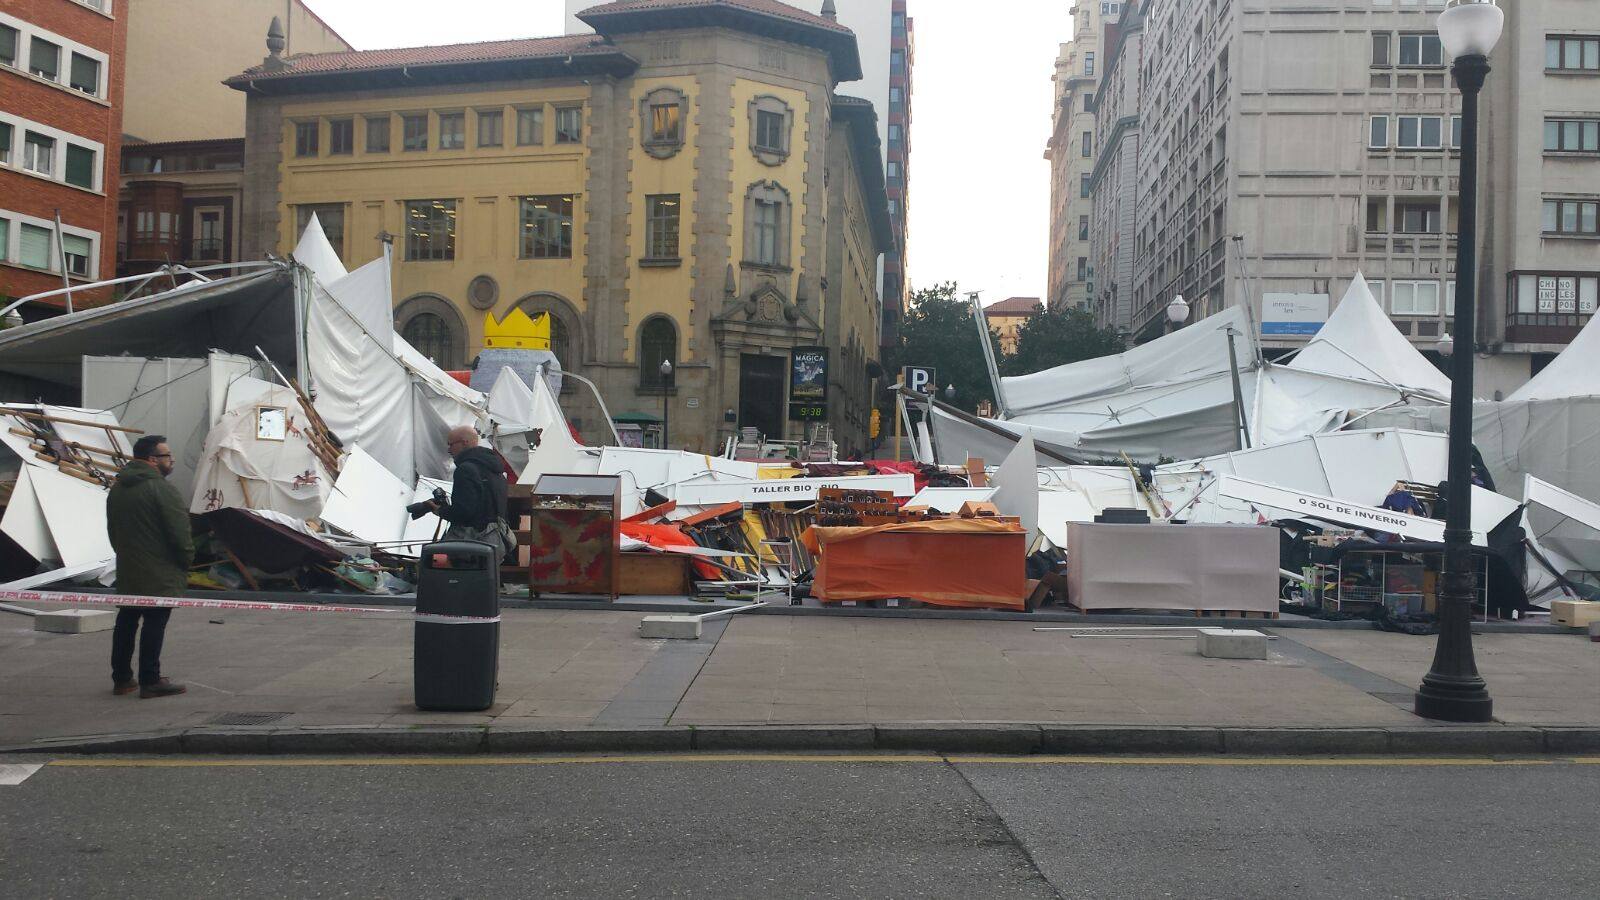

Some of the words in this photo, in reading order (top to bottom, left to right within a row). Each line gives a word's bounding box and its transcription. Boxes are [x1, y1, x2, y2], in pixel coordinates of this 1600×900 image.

[912, 368, 929, 392] P
[801, 407, 822, 416] 9:38
[752, 485, 791, 494] TALLER
[793, 484, 812, 493] BIO
[1310, 500, 1333, 511] SOL
[1336, 506, 1351, 515] DE
[1354, 510, 1408, 527] INVERNO
